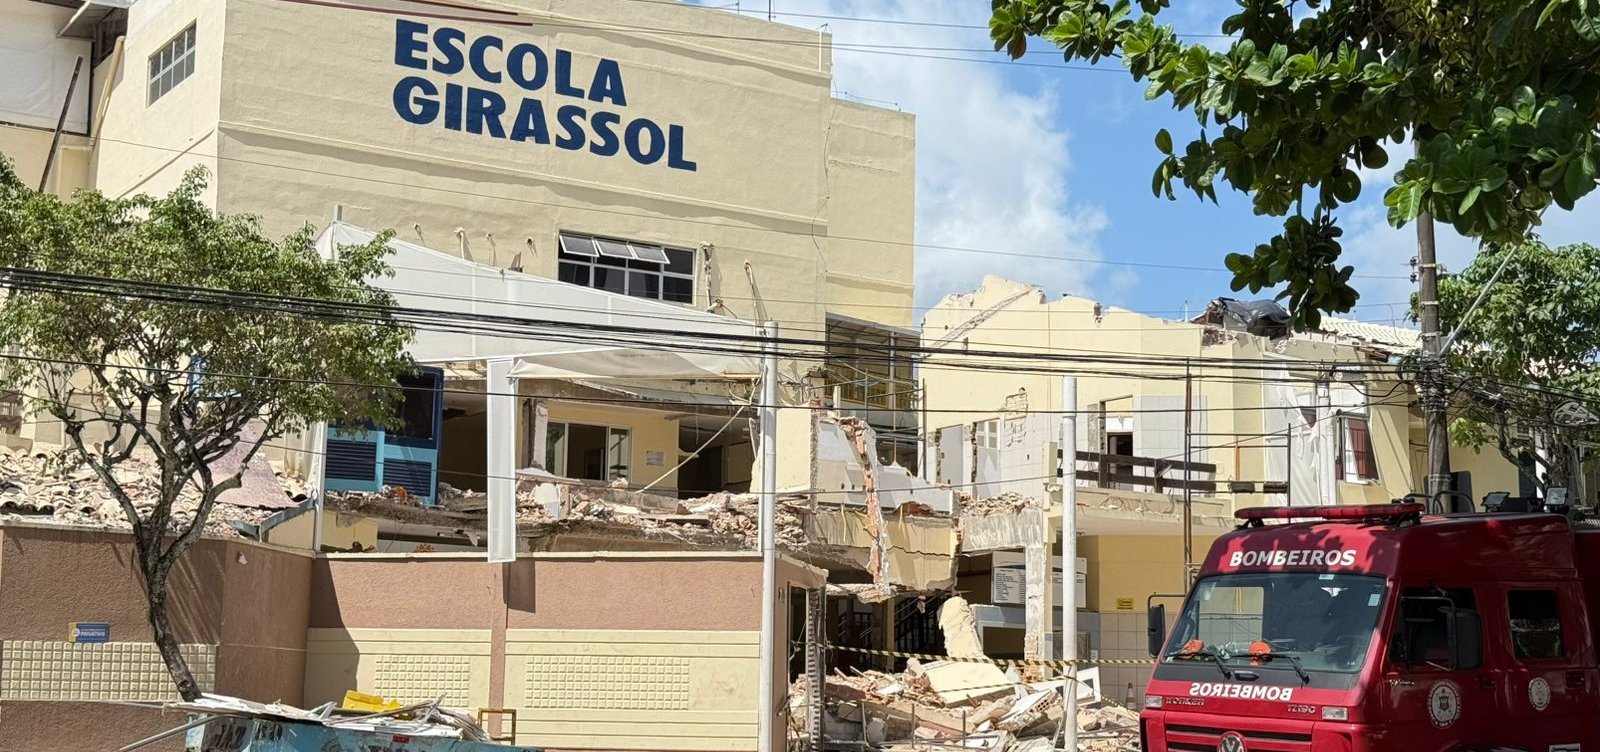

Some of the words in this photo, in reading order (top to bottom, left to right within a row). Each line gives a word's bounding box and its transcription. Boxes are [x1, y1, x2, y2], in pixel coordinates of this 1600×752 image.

[394, 18, 627, 107] ESCOLA
[393, 75, 697, 172] GIRASSOL
[1229, 549, 1357, 567] BOMBEIROS
